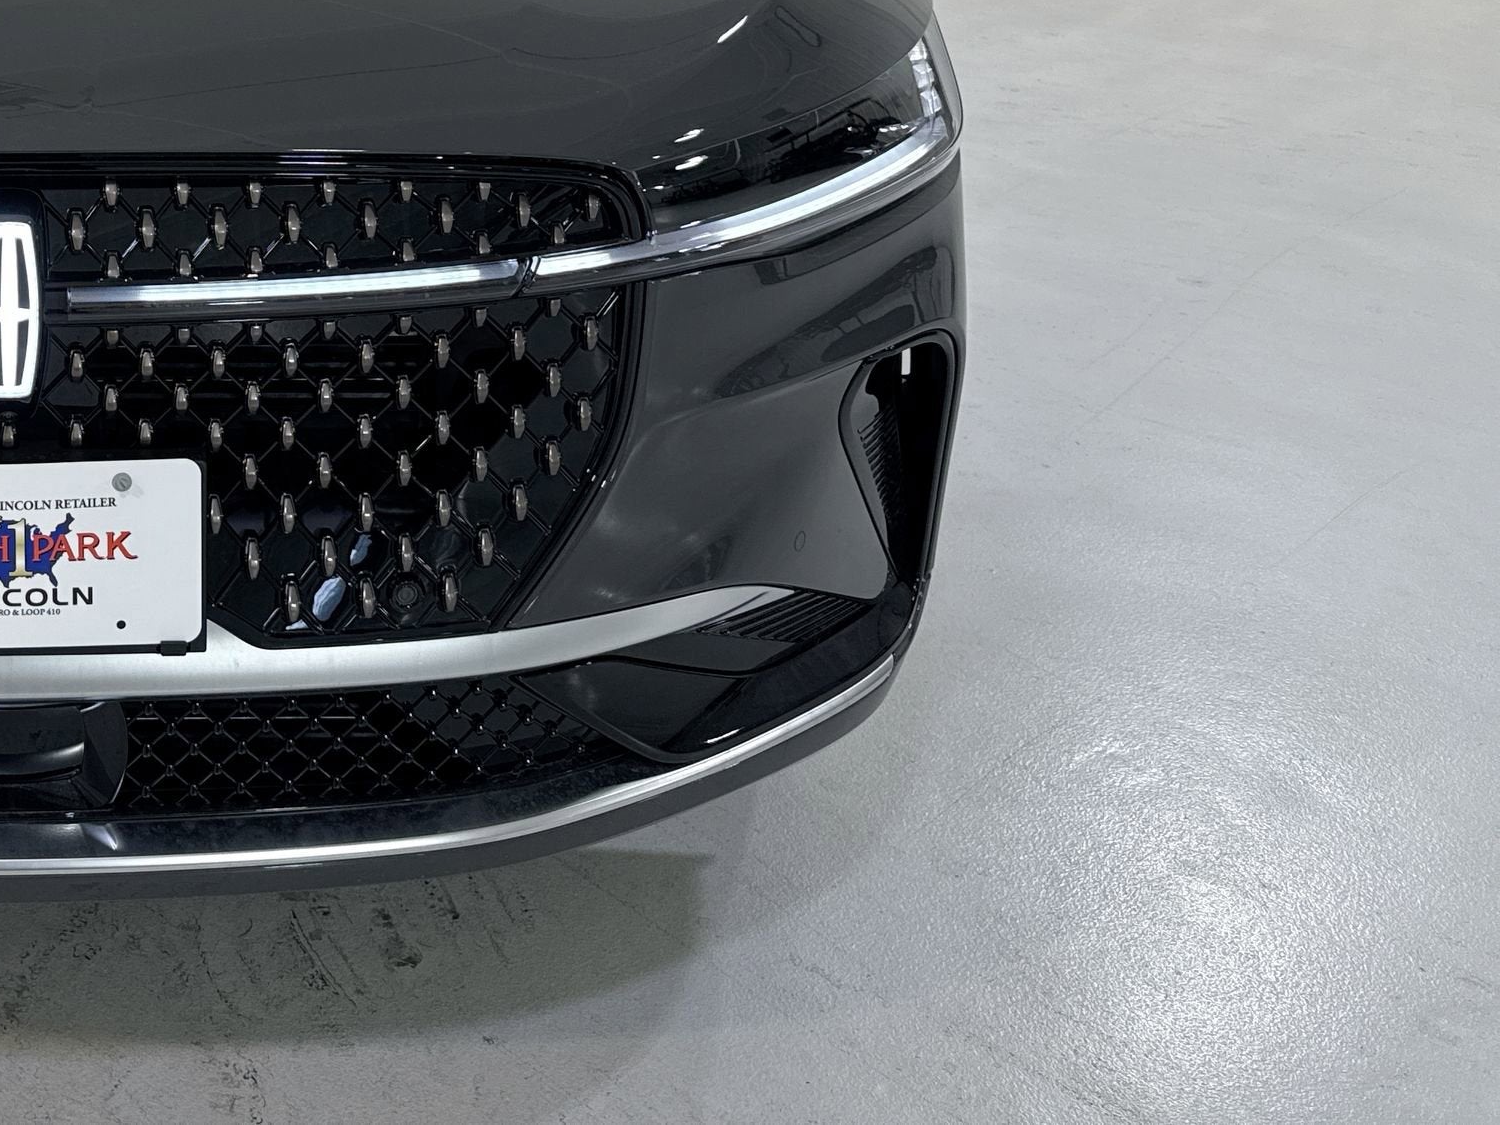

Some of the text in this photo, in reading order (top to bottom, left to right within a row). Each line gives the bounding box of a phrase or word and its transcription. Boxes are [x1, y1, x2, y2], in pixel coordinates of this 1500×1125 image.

[55, 497, 117, 509] RETAILER
[31, 530, 138, 563] PARK
[21, 608, 46, 616] LOOP
